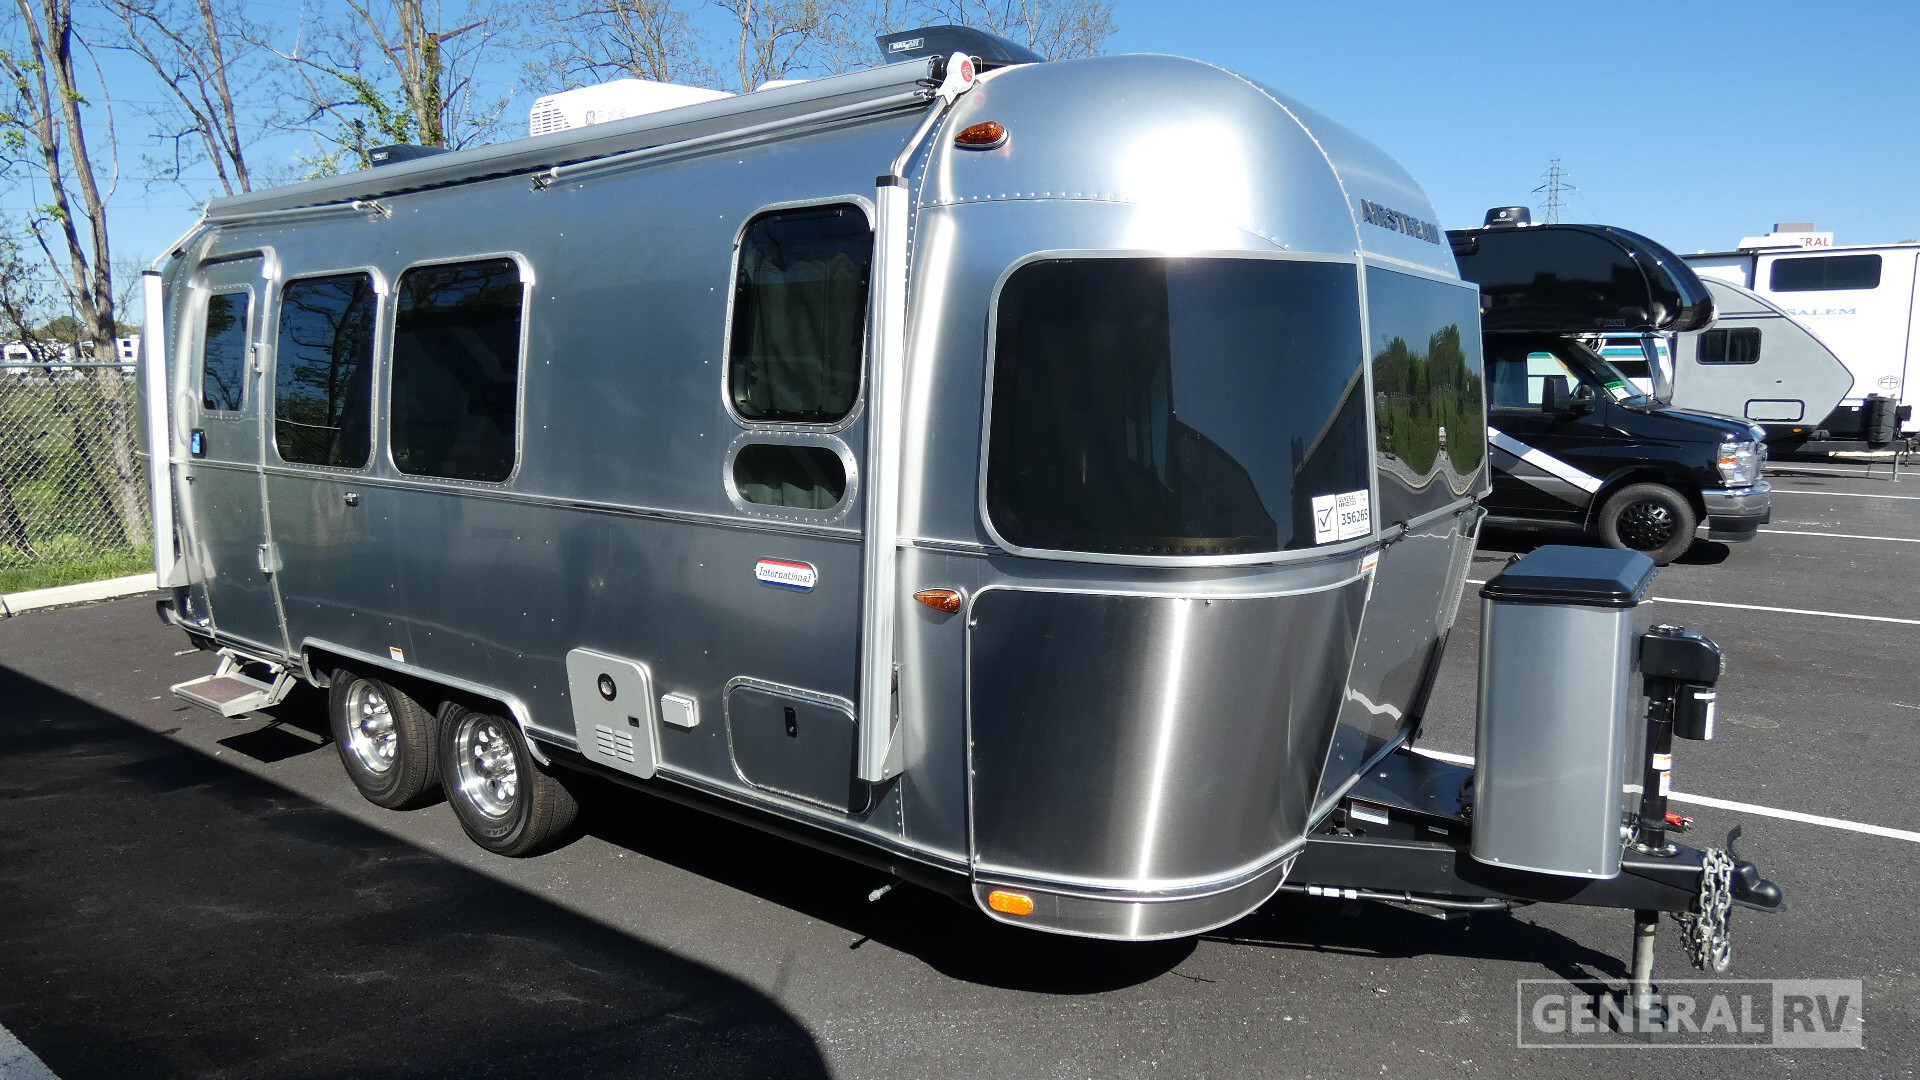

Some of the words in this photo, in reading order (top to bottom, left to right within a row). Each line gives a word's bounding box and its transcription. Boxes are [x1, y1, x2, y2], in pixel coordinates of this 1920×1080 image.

[1360, 198, 1440, 246] AIRSTREAM
[1785, 307, 1857, 317] SALEM
[1341, 508, 1369, 526] 356265
[758, 566, 812, 583] International
